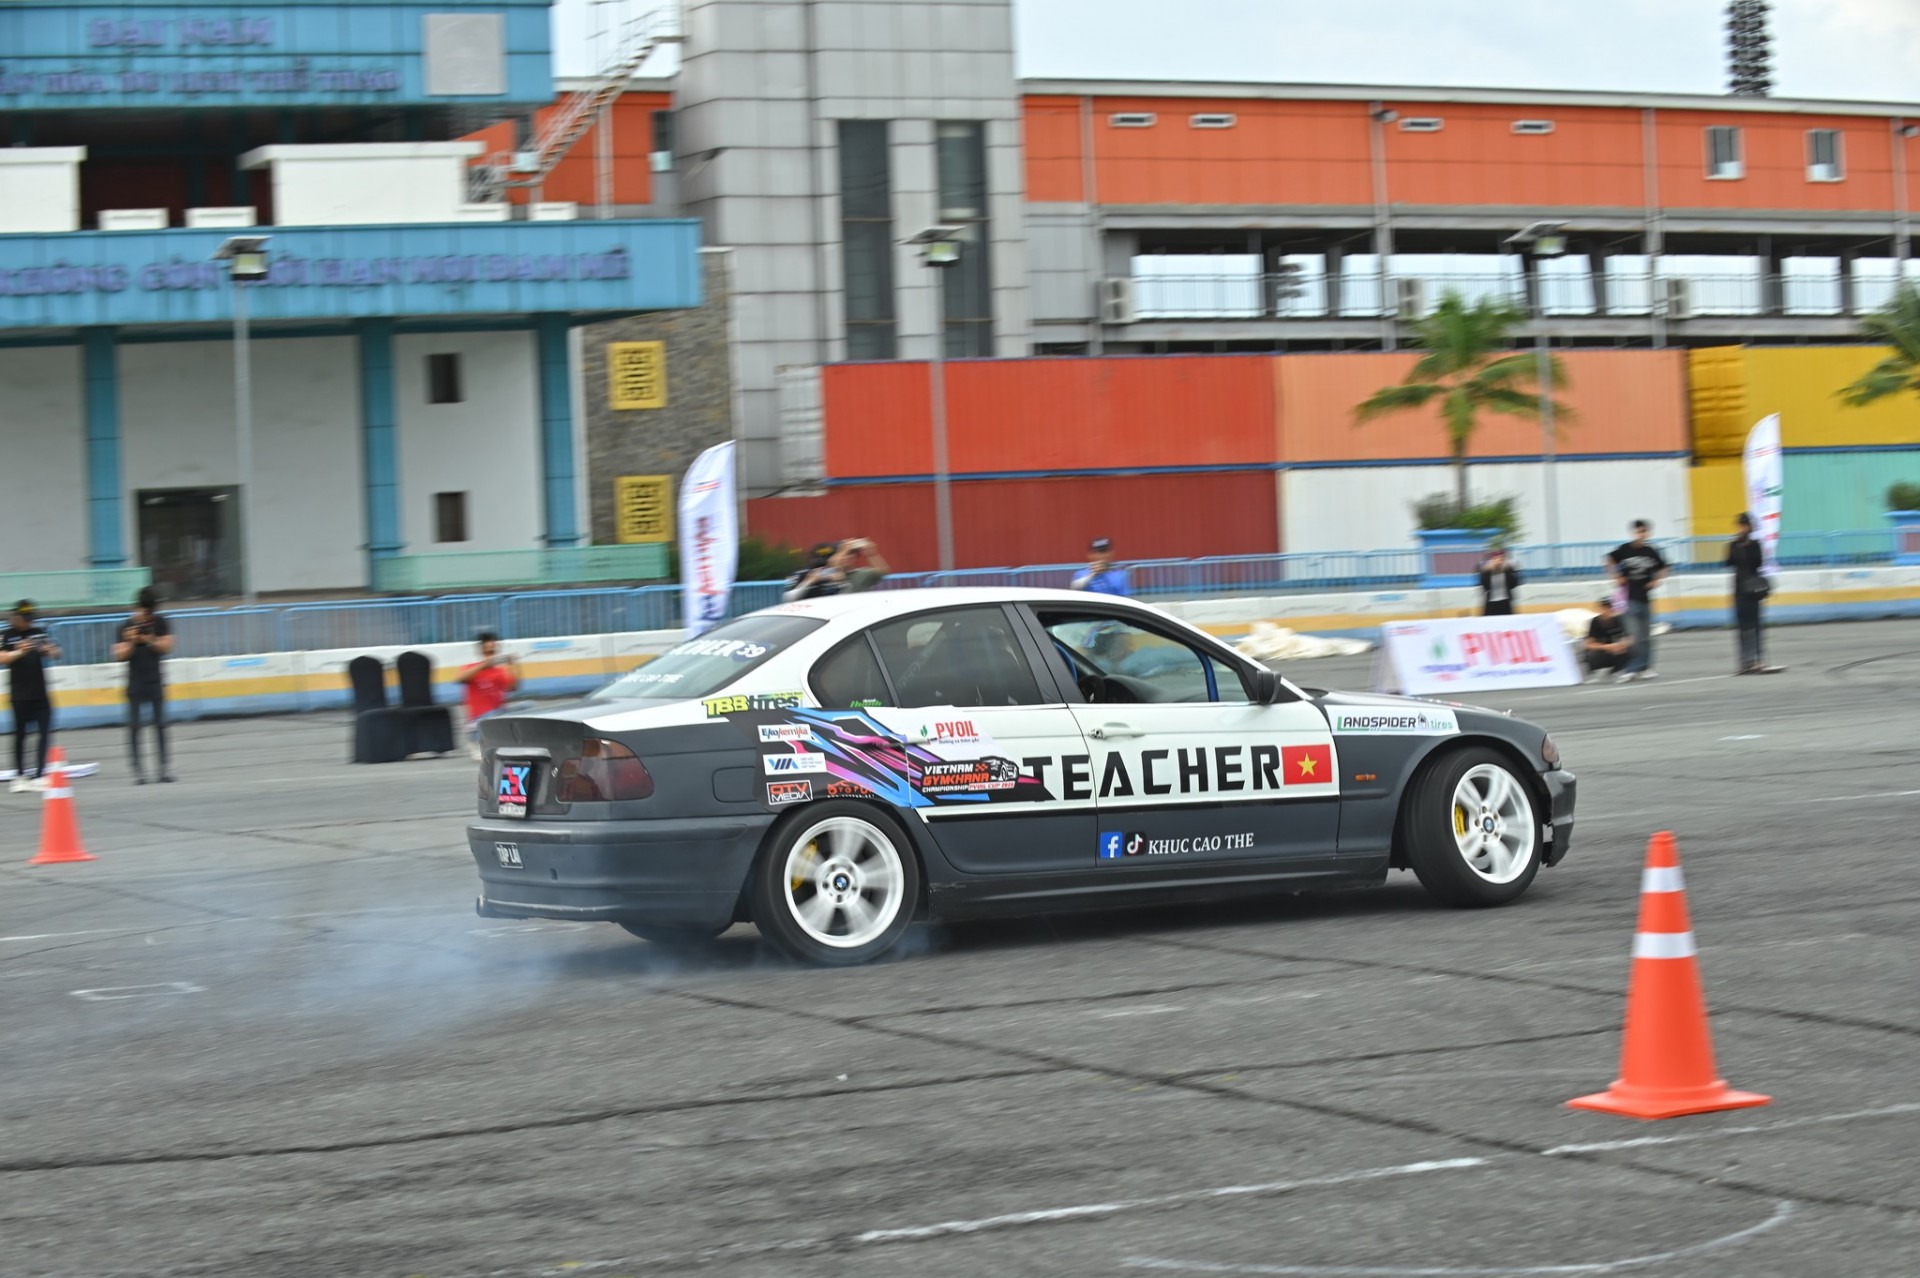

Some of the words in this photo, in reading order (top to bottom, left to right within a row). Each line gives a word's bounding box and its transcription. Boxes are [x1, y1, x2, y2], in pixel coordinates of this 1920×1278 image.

[178, 16, 274, 46] NAM
[935, 721, 978, 737] PVOIL
[1336, 715, 1417, 731] LANDSPIDER
[1430, 719, 1453, 730] tires
[924, 764, 973, 775] VIETNAM
[1022, 744, 1281, 801] TEACHER
[922, 773, 989, 786] GYMKHANA
[922, 785, 969, 793] CHAMPIONSHIP
[1148, 838, 1190, 855] KHUC
[1192, 835, 1221, 852] CAO
[1225, 832, 1254, 850] THE
